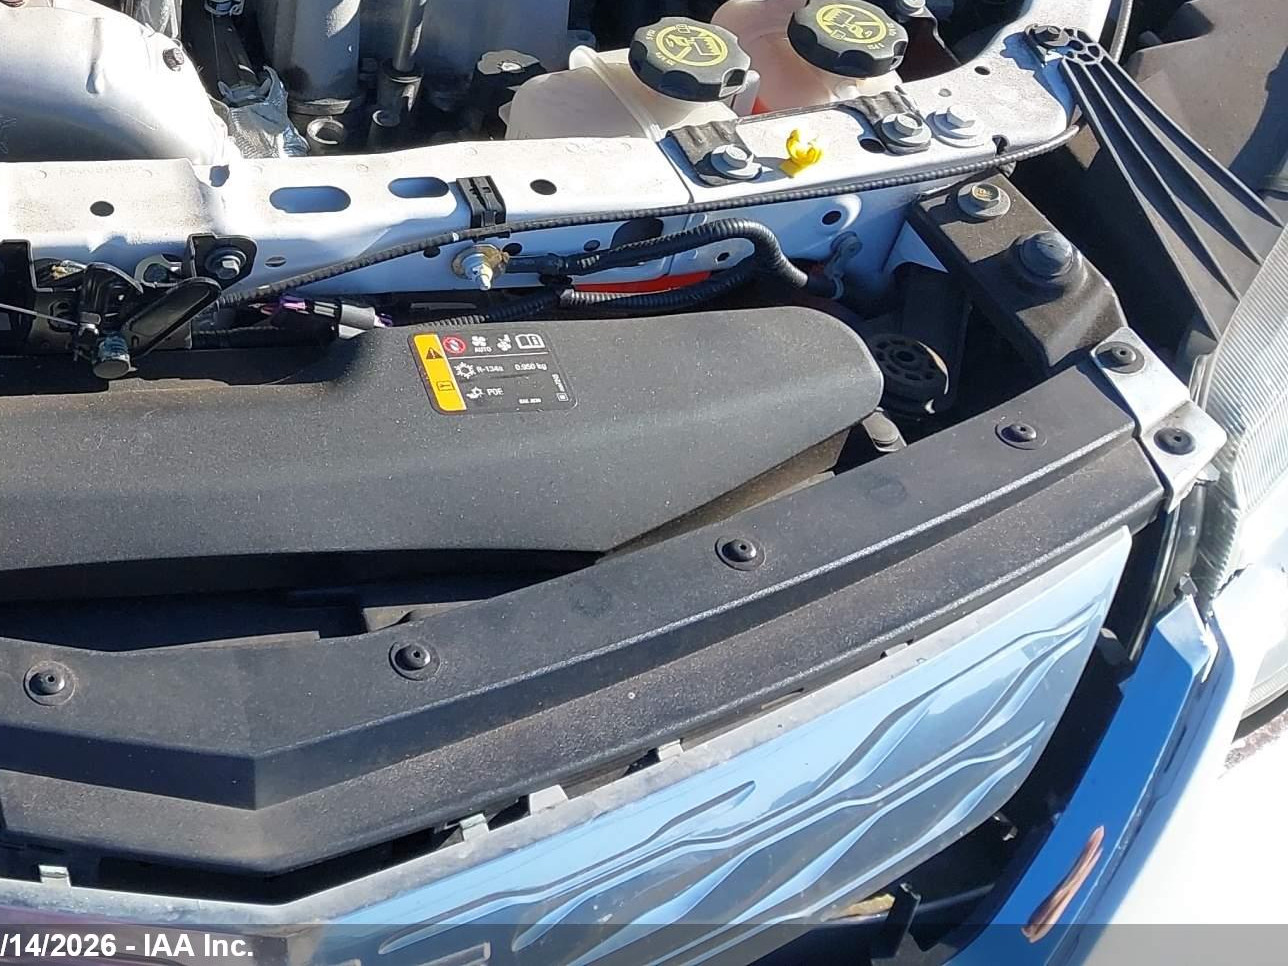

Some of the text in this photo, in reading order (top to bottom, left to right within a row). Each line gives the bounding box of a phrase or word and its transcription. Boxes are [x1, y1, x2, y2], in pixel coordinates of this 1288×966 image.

[476, 365, 504, 373] R-134a
[536, 362, 548, 371] kg
[486, 387, 504, 396] POE
